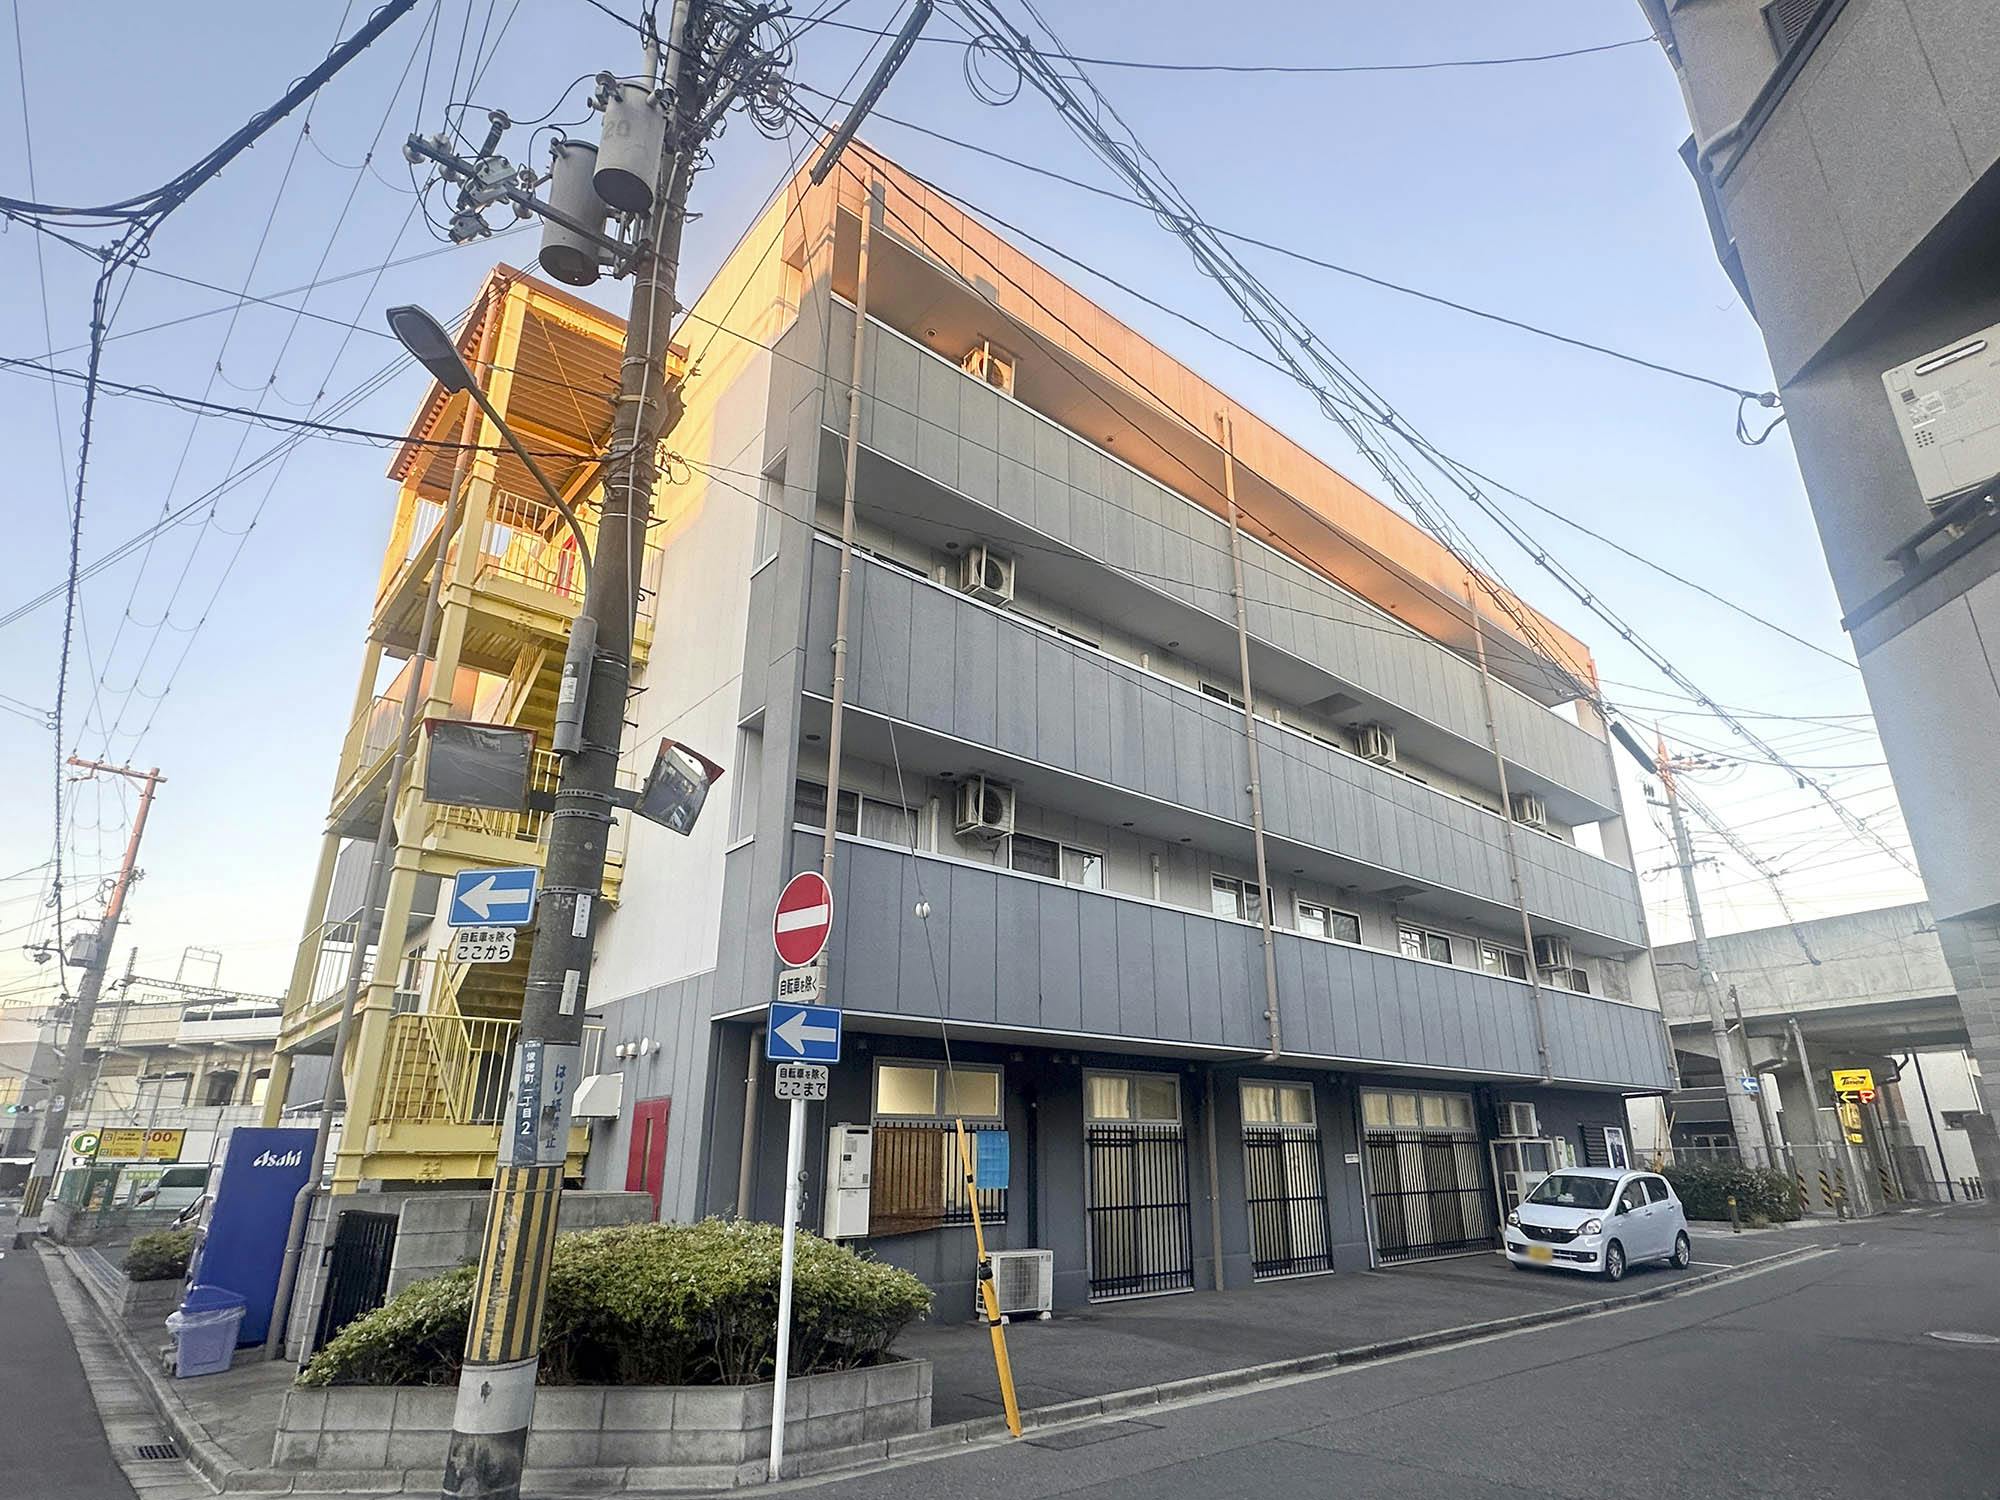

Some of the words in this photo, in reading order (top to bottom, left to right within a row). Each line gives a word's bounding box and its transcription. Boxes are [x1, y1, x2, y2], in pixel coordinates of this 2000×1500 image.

[460, 930, 513, 943] 自転車を除く
[457, 945, 510, 960] ここから
[780, 975, 817, 996] 自転車を除く
[780, 1067, 826, 1080] 自転車を除く
[778, 1081, 826, 1097] ここまで
[80, 1136, 98, 1152] P
[253, 1149, 303, 1167] Asahi
